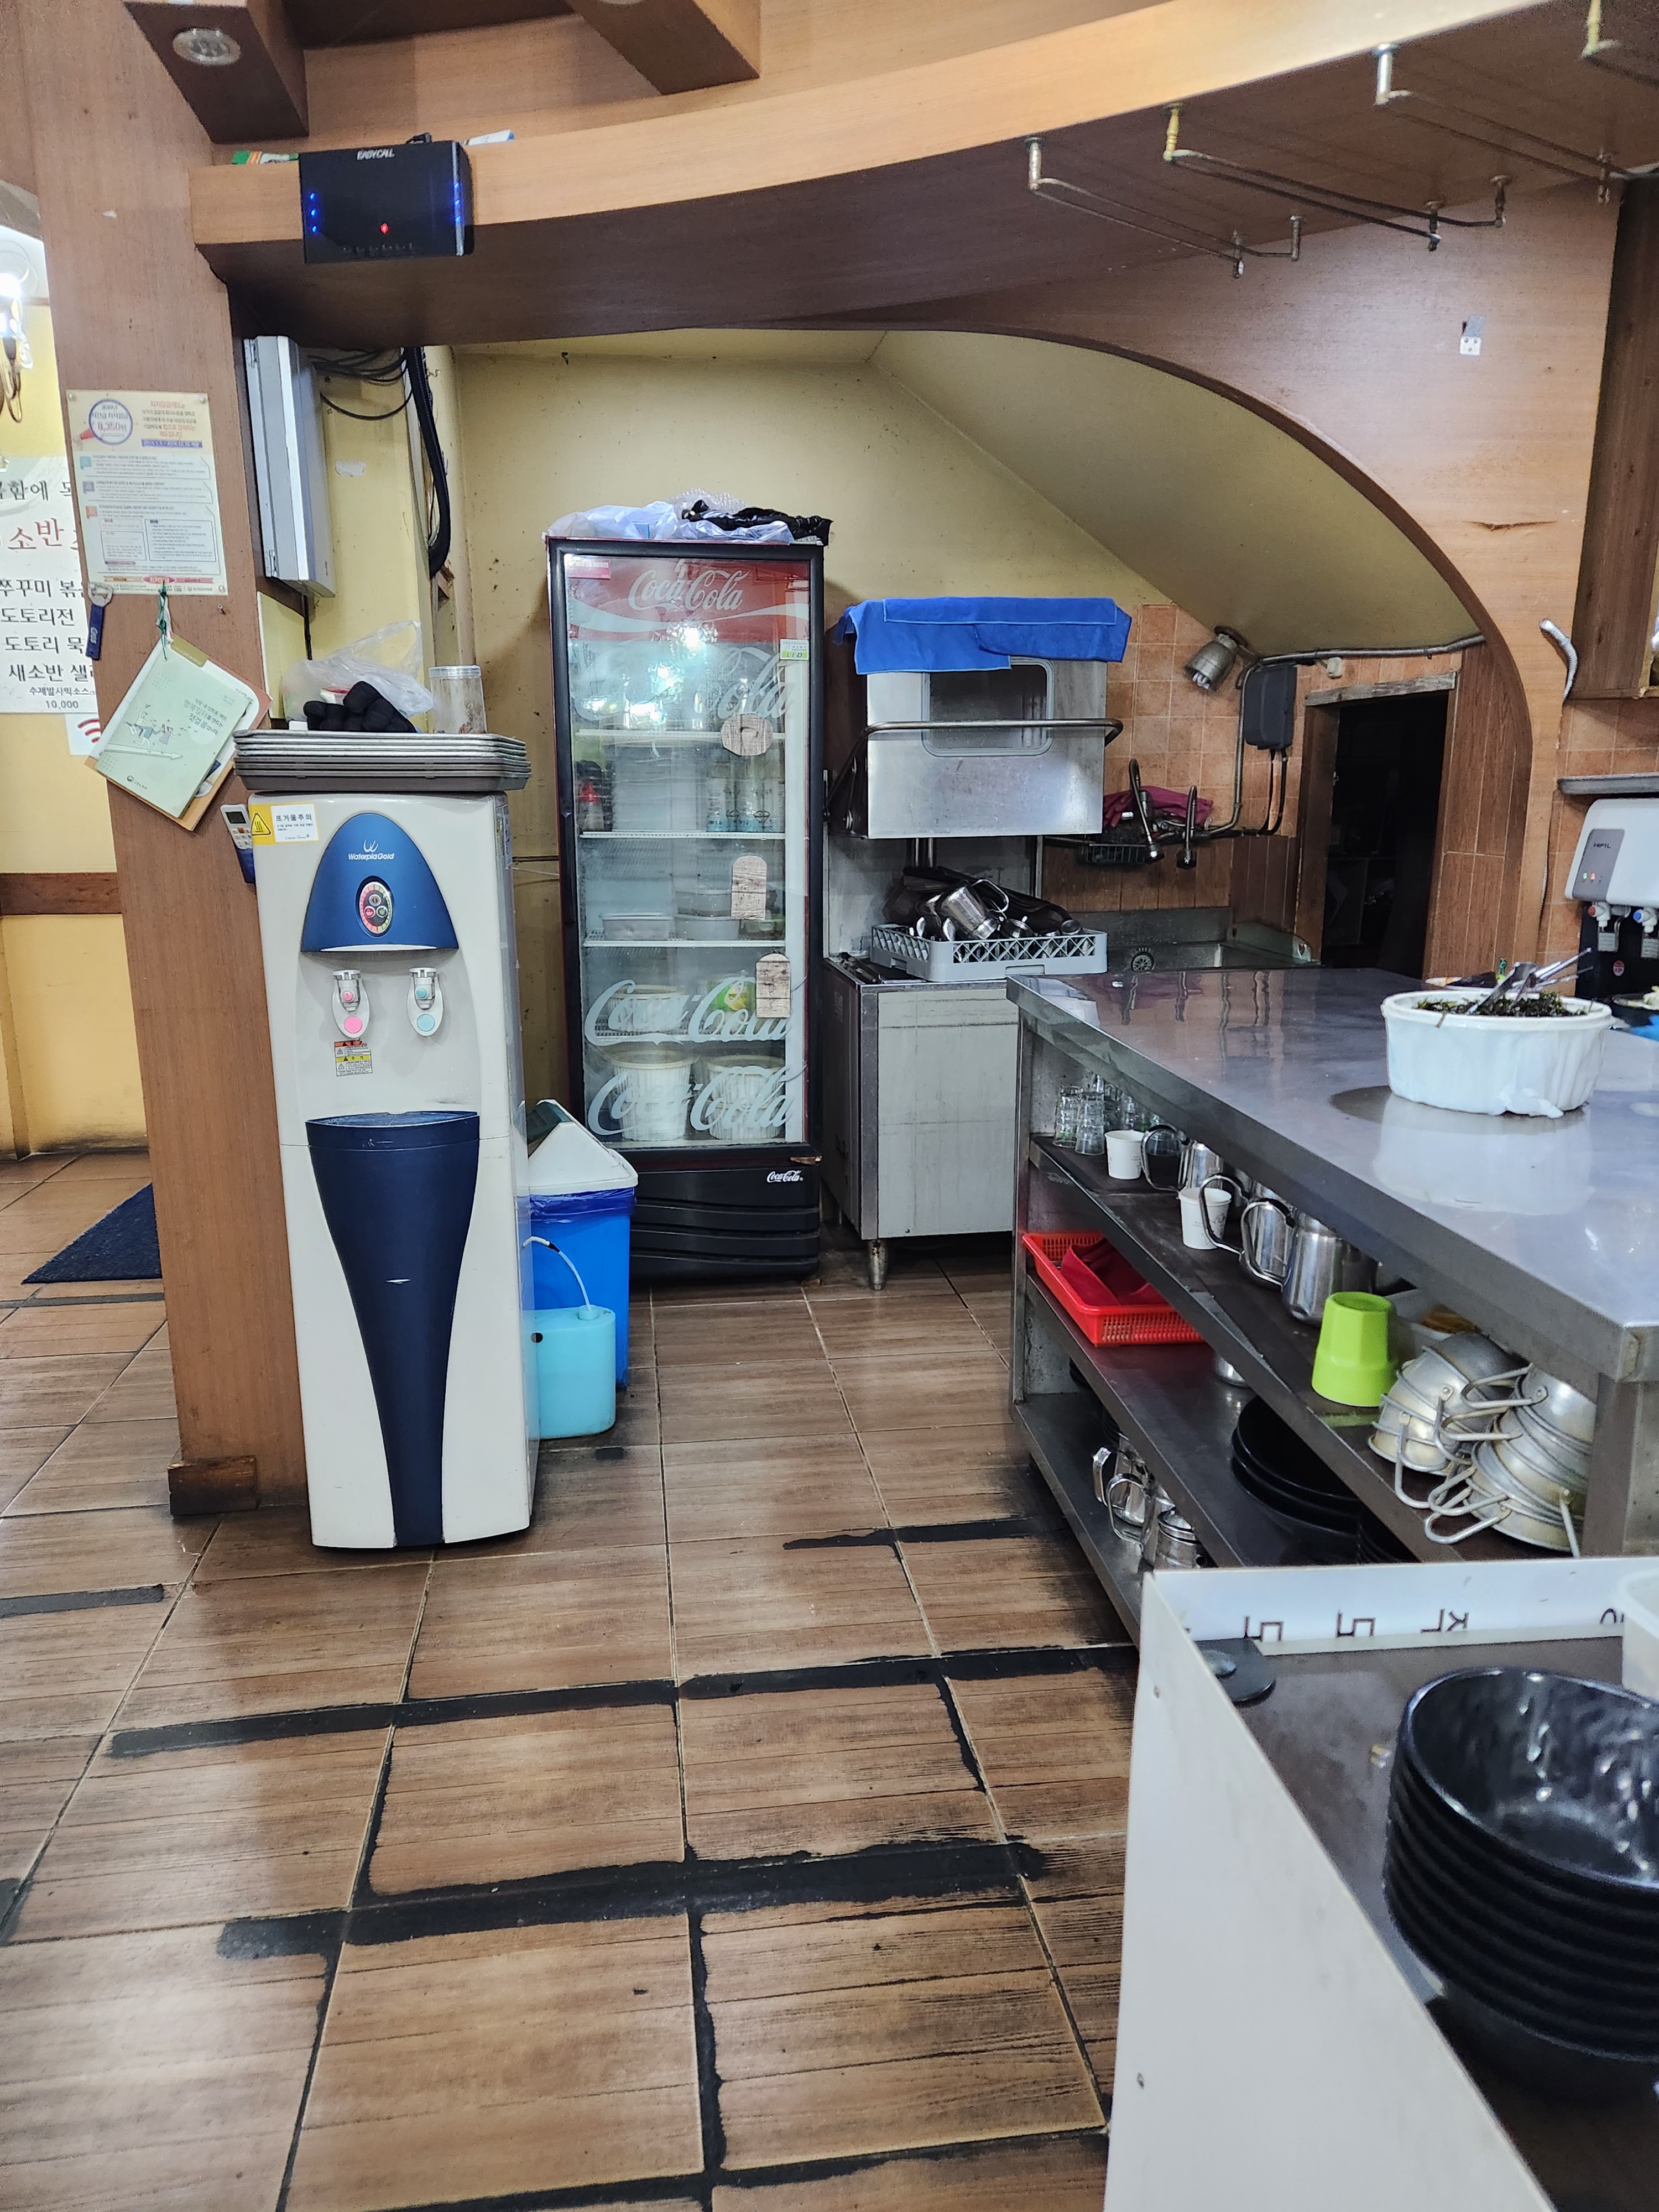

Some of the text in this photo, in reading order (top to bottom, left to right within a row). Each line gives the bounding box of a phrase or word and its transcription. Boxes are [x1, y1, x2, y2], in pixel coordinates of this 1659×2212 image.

[1, 607, 75, 626] 도토리전
[6, 637, 84, 654] 도토리 묵
[9, 664, 64, 682] 새소반
